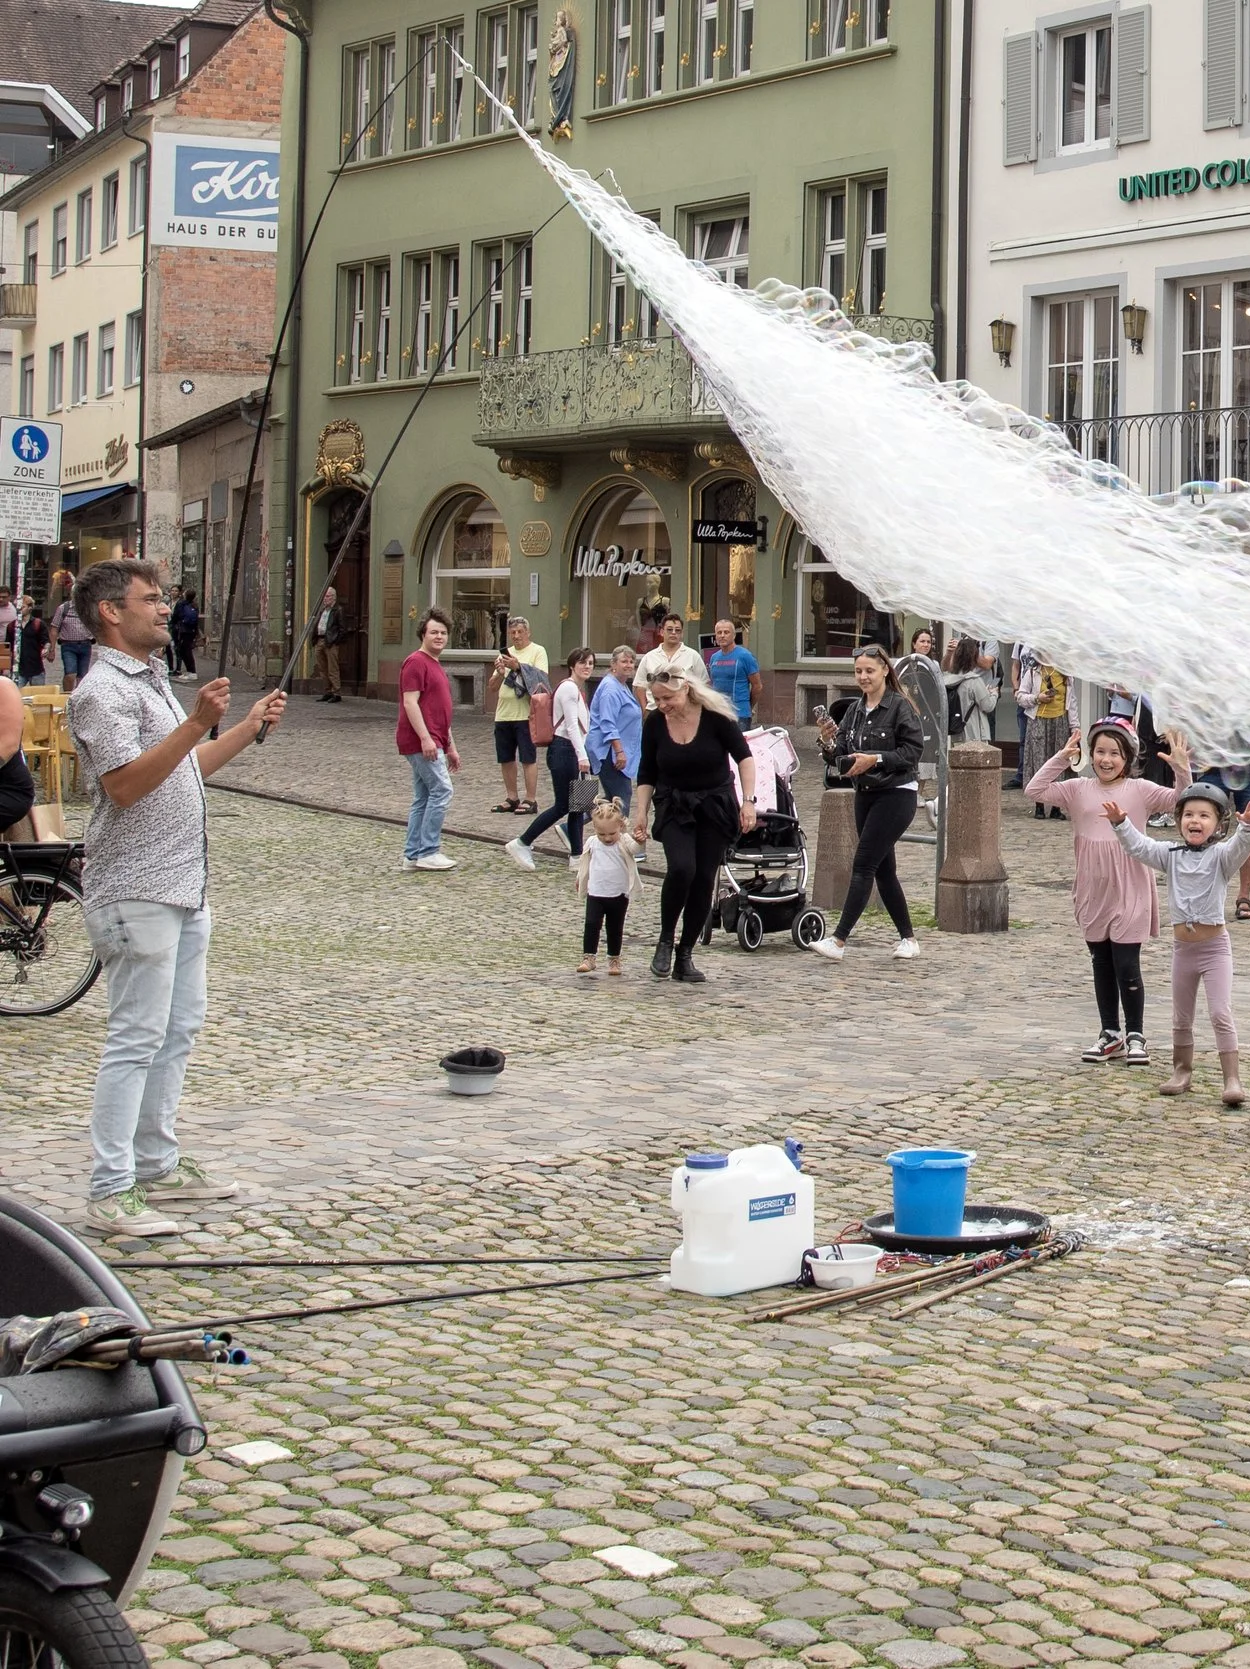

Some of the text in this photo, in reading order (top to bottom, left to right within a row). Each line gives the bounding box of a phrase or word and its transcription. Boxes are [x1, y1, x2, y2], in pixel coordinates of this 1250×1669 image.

[1119, 166, 1199, 202] UNITED
[167, 222, 207, 235] HAUS
[218, 225, 246, 238] DER
[13, 466, 45, 479] ZONE
[697, 523, 753, 541] Ulla Popken
[575, 545, 671, 586] Ulla Popken
